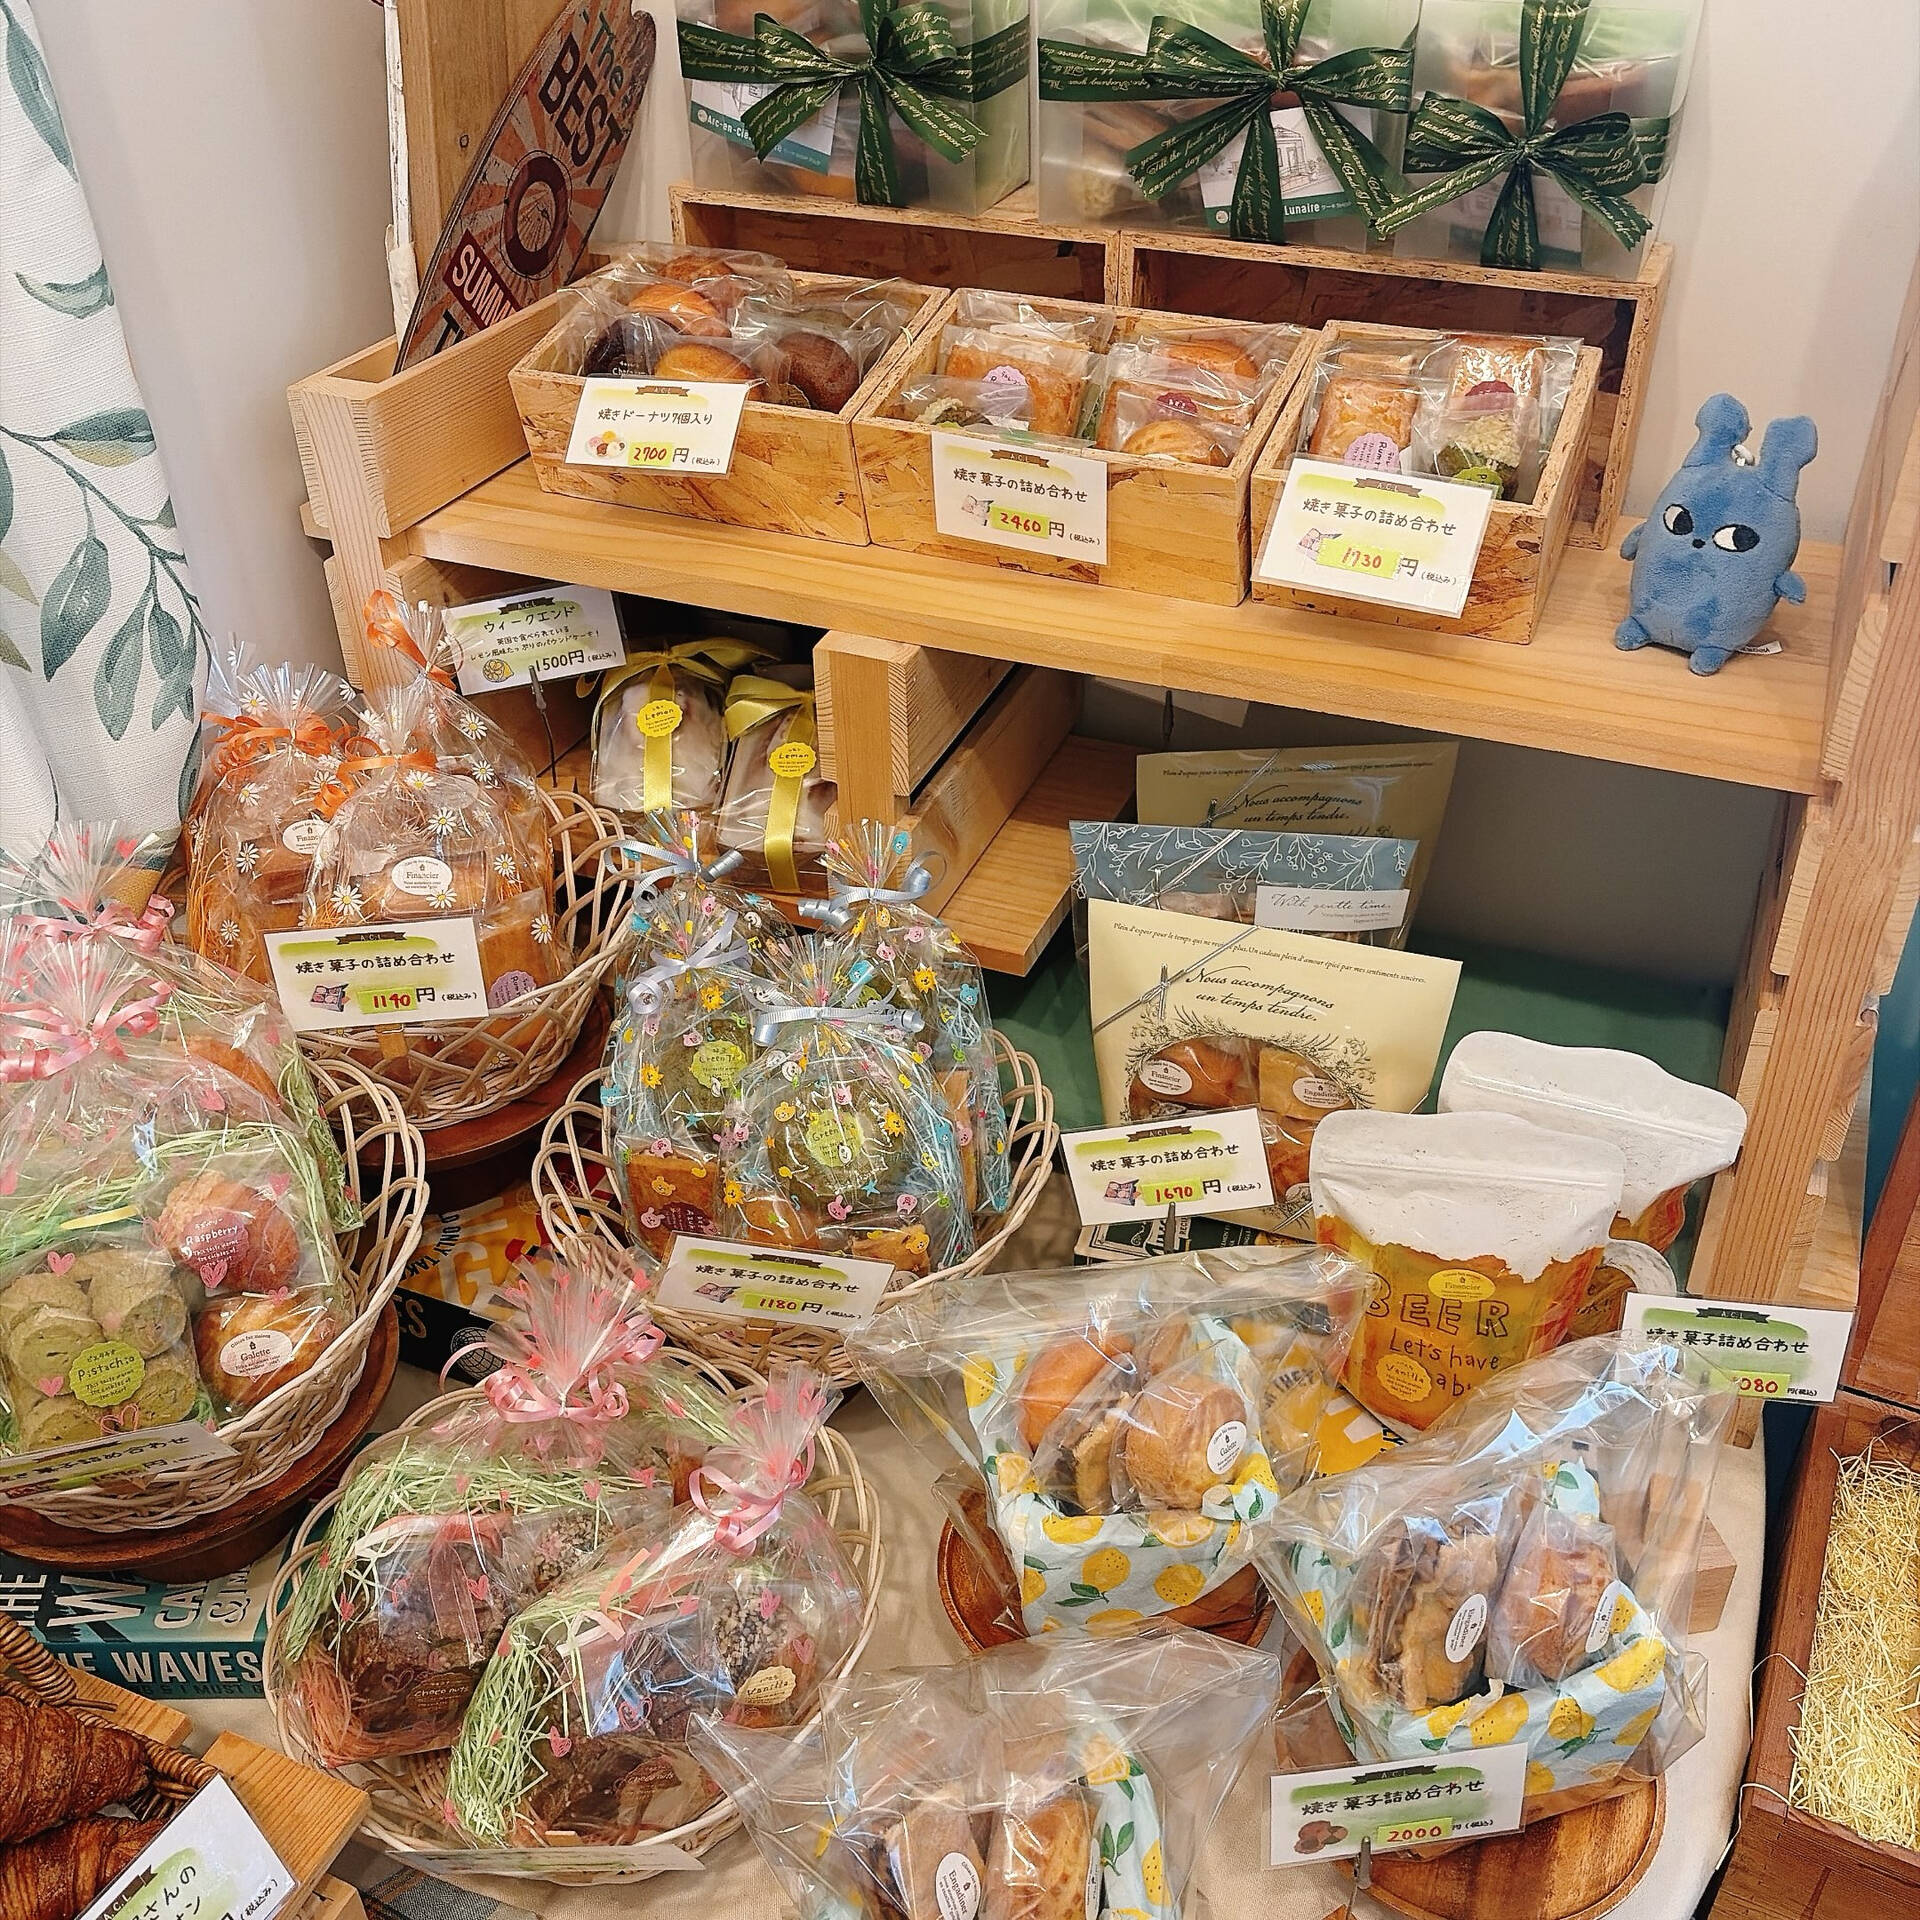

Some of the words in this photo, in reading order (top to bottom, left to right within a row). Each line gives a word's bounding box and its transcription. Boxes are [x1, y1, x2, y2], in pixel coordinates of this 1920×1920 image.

[538, 32, 624, 187] BEST
[1284, 202, 1320, 215] Lunaire
[597, 408, 713, 426] 焼きドーナツ7個入り
[953, 467, 1088, 503] 焼き菓子の詰め合わせ
[1302, 497, 1458, 538] 焼き菓子の詰め合わせ
[483, 605, 577, 634] ウィークエンド
[496, 625, 570, 646] 英国で食べられている
[534, 649, 585, 673] 1500円
[645, 707, 675, 721] Lemon
[778, 752, 810, 760] Lemon
[1239, 784, 1289, 808] Nous
[1272, 792, 1363, 808] accompagnons
[1264, 808, 1304, 826] temps
[406, 871, 440, 880] Financier
[295, 951, 456, 975] 焼き菓子の詰め合わせ
[1113, 922, 1129, 933] Plein
[1152, 931, 1169, 939] pour
[1168, 931, 1175, 940] le
[1174, 934, 1192, 945] temps
[1192, 938, 1203, 946] qui
[1258, 949, 1281, 959] cadeau
[1281, 952, 1298, 963] plein
[1340, 963, 1354, 973] par
[1366, 968, 1400, 980] sentiments
[1185, 965, 1251, 985] Nous
[1230, 975, 1335, 1010] accompagnons
[1195, 991, 1217, 1003] un
[1219, 993, 1264, 1014] temps
[1267, 1001, 1318, 1023] tendre.
[1089, 1144, 1240, 1173] 焼き菓子の詰め合わせ
[185, 1225, 238, 1246] Raspberry
[433, 1225, 461, 1257] ONLY
[694, 1264, 860, 1294] 焼き菓子の詰め合わせ
[1389, 1326, 1442, 1362] Let's
[1450, 1345, 1500, 1371] have
[78, 1355, 135, 1382] Pistachio
[110, 1651, 263, 1684] WAVES
[747, 1679, 789, 1697] Vanilla
[1301, 1780, 1485, 1816] 焼き菓子詰め合わせ
[1386, 1825, 1443, 1844] 2000
[948, 1869, 968, 1916] Engadiner
